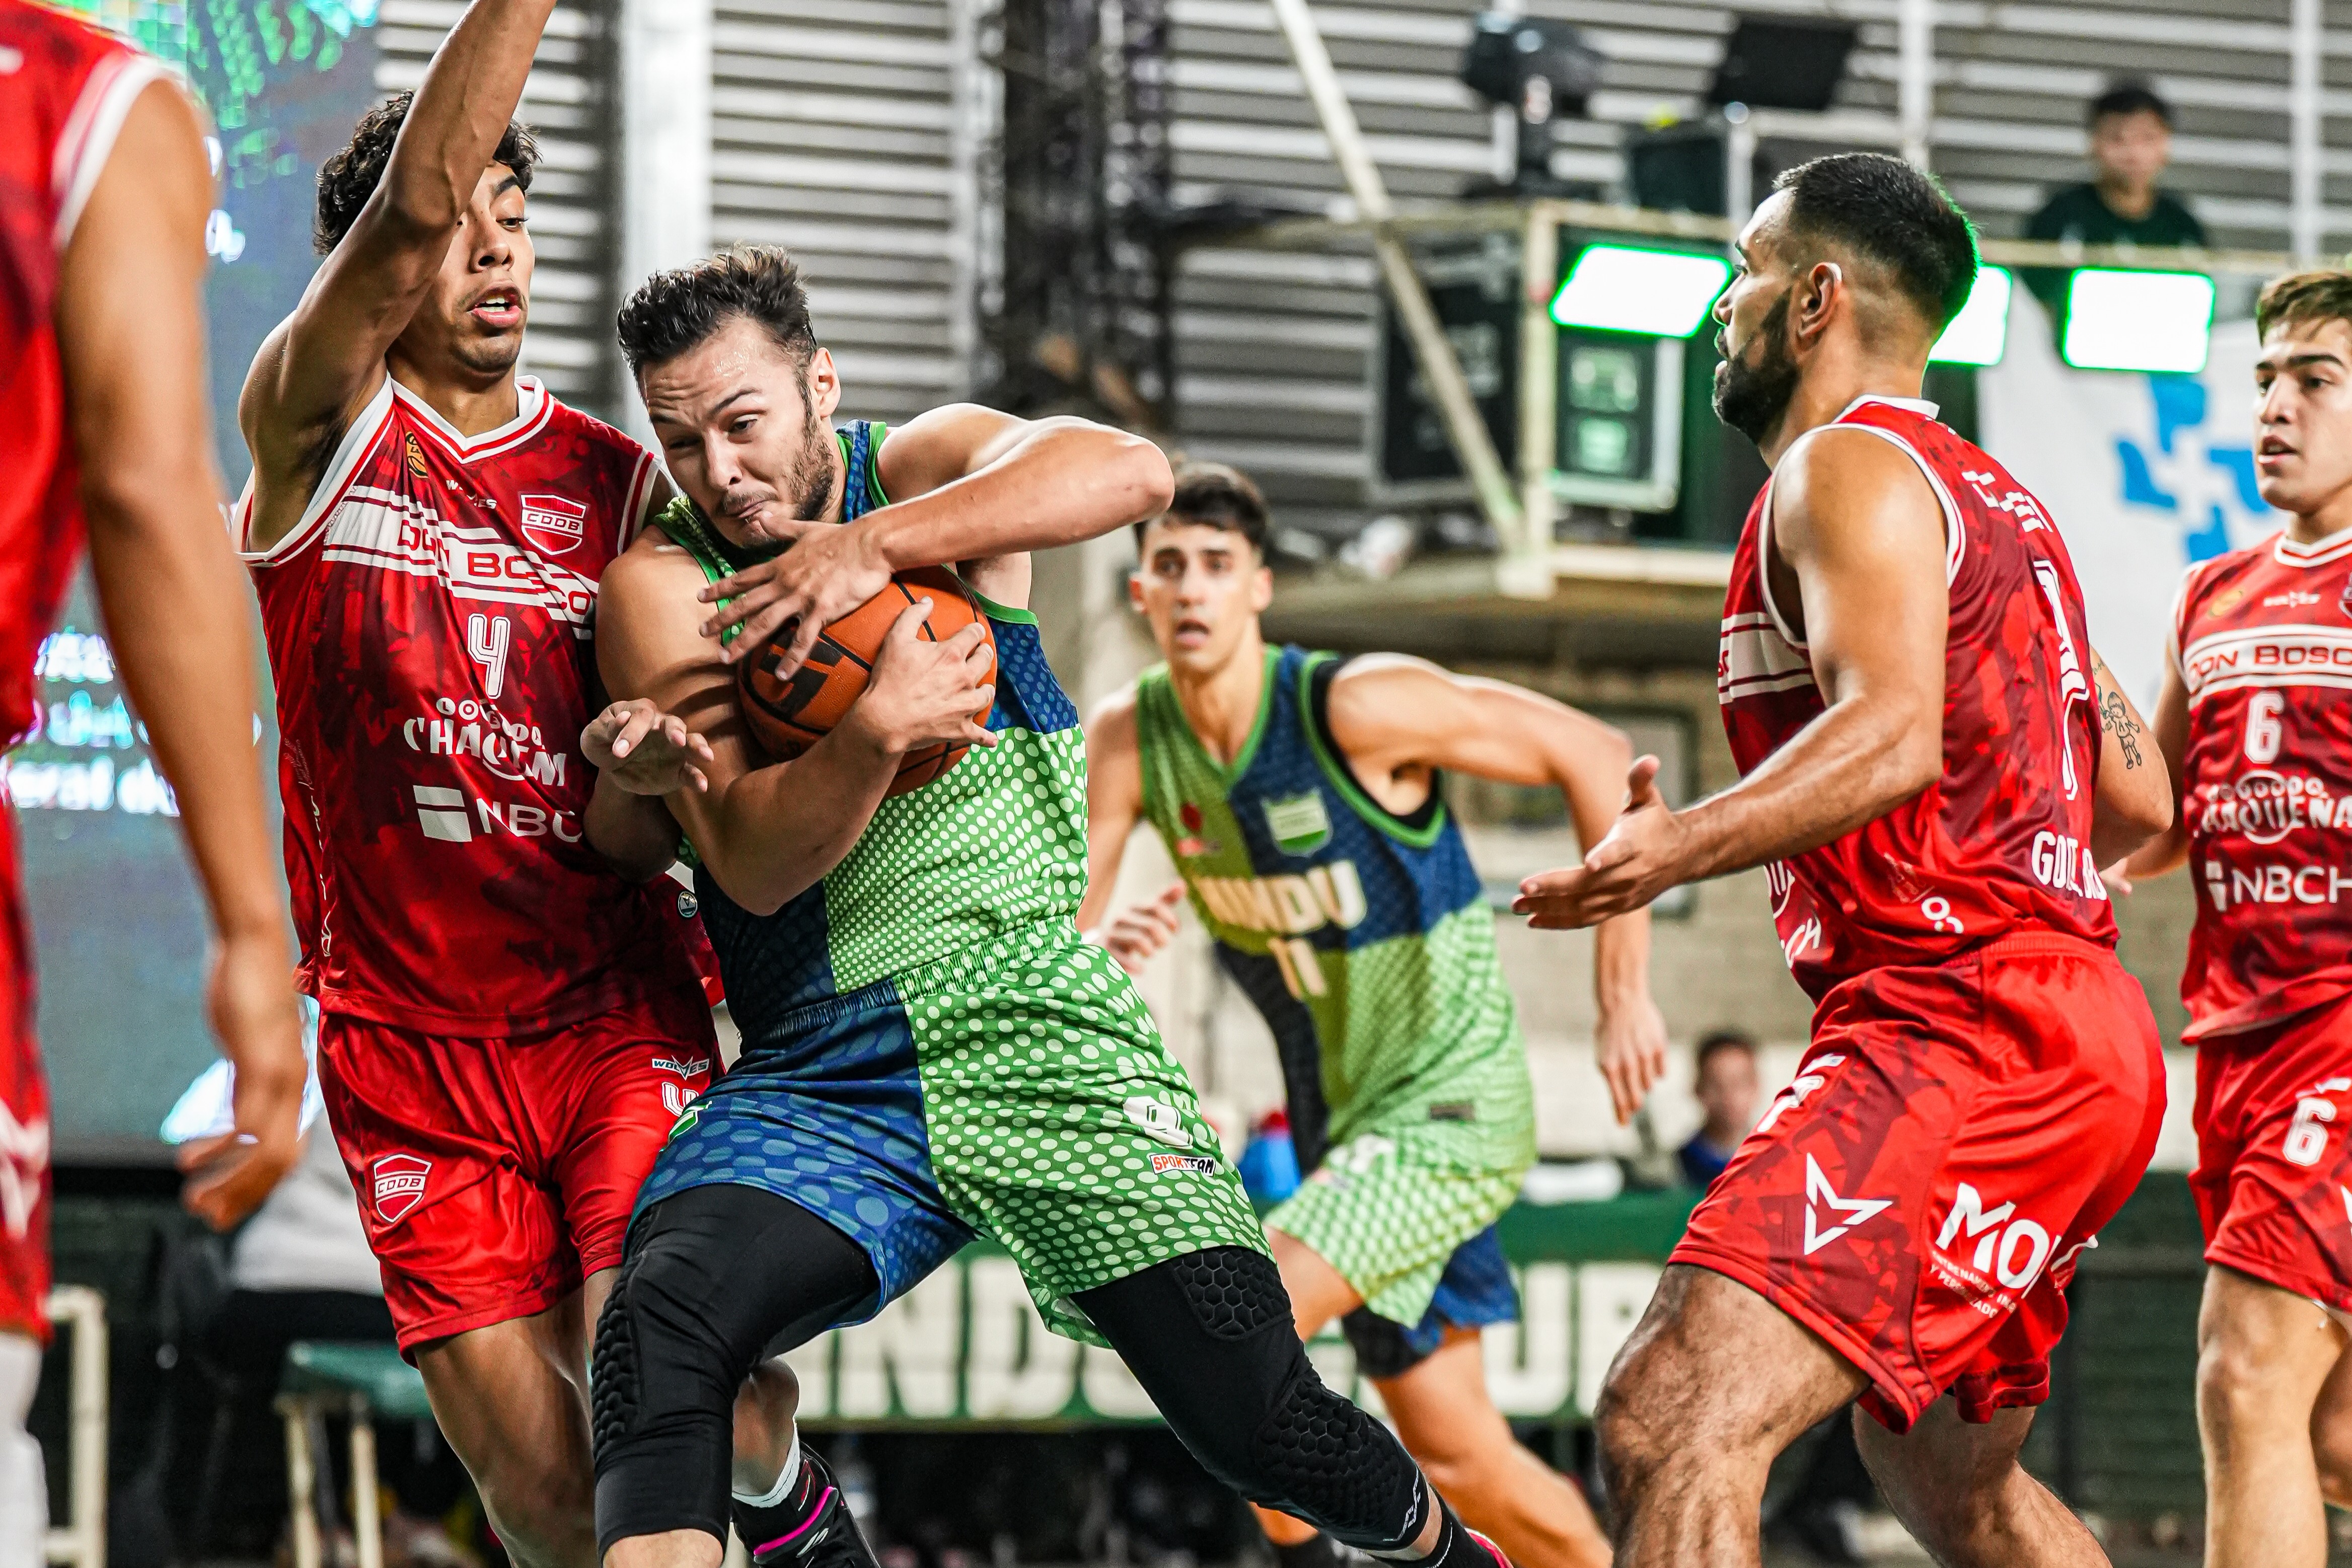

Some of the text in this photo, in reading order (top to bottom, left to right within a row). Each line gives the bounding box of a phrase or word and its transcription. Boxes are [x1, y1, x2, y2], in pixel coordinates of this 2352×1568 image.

[468, 613, 510, 699] 4
[2254, 645, 2352, 666] BOSC
[2243, 691, 2285, 764] 6
[476, 797, 583, 843] NBC
[2283, 1098, 2336, 1167] 6
